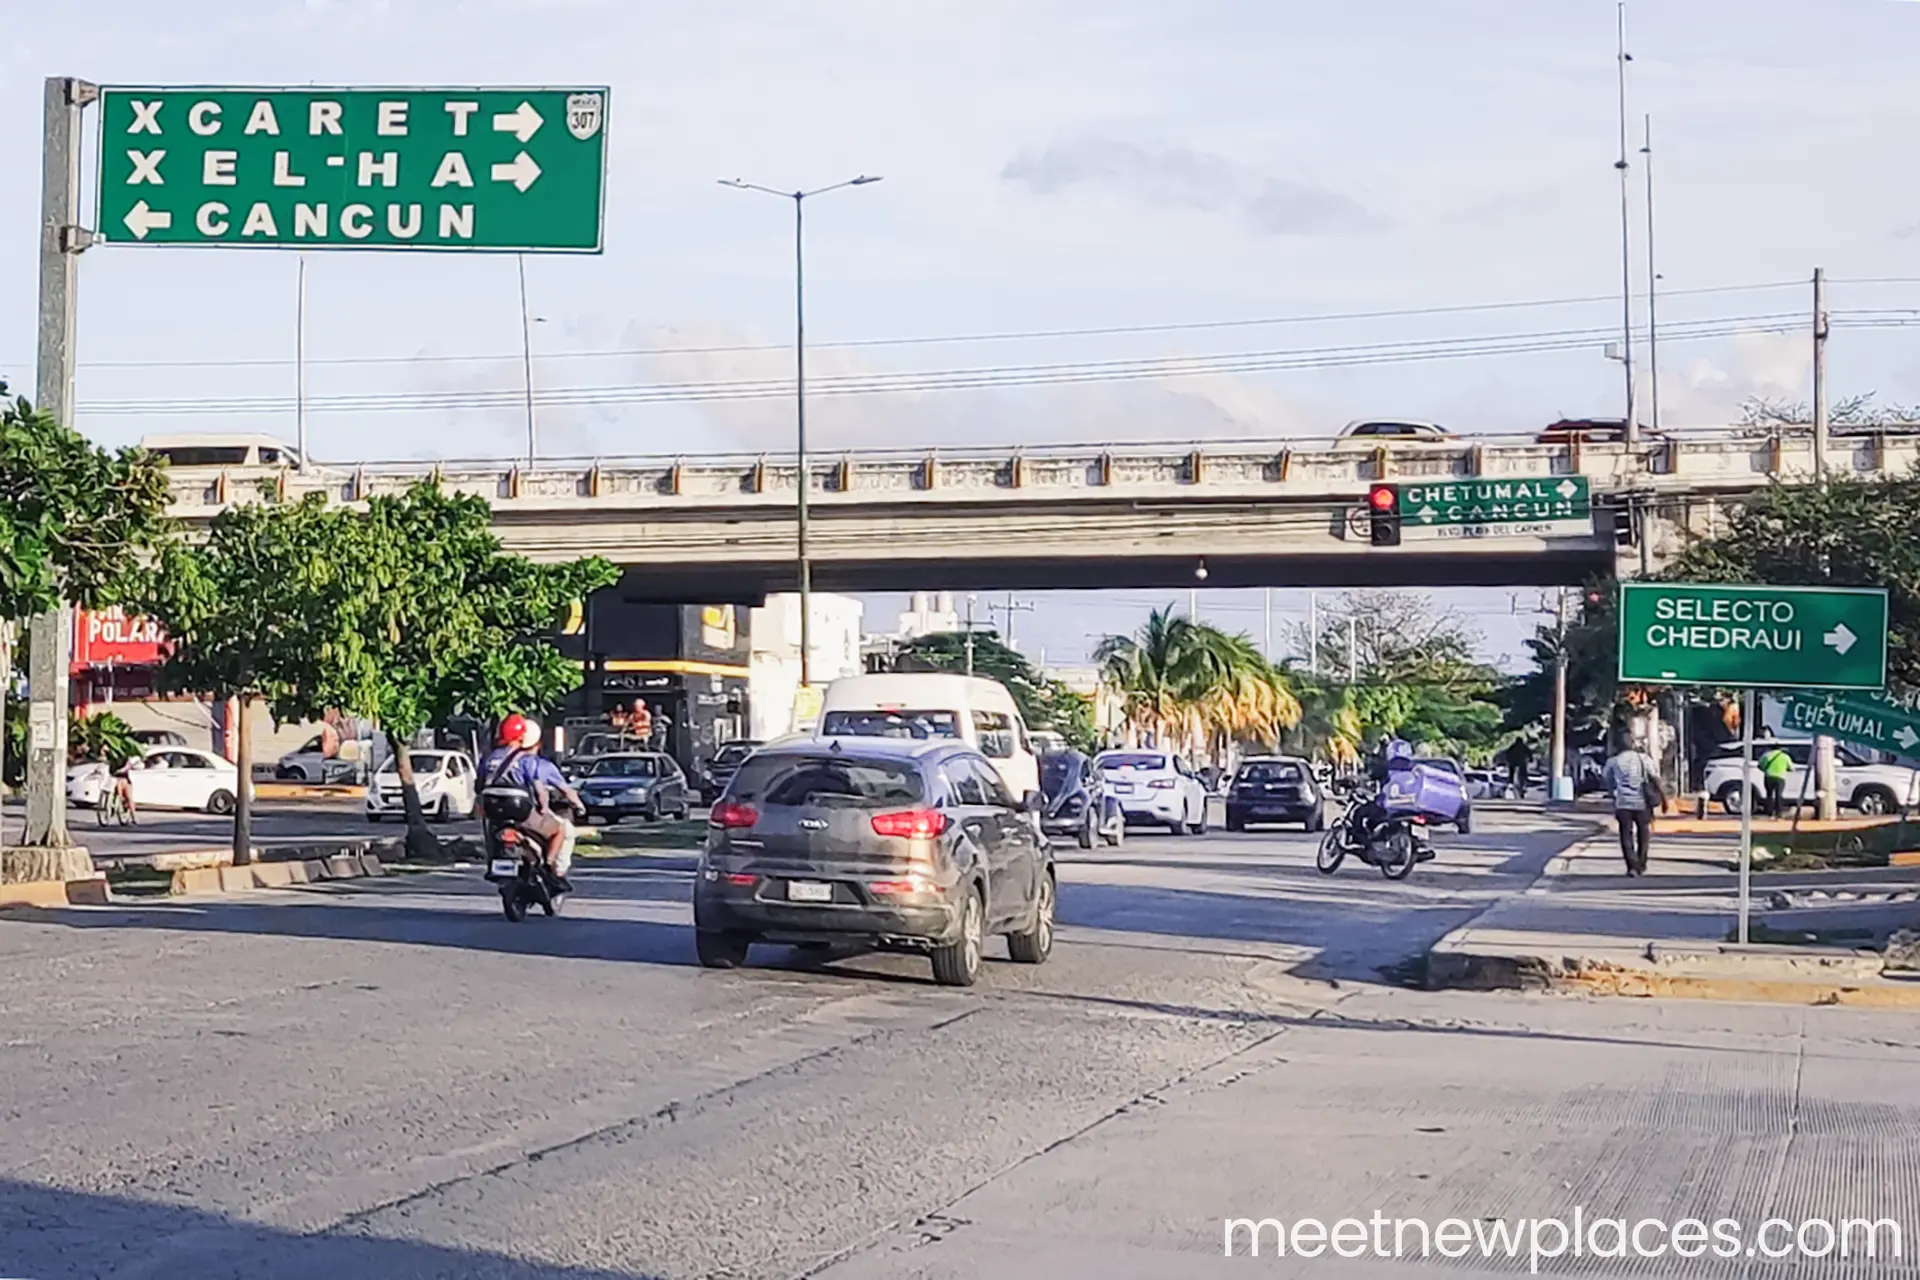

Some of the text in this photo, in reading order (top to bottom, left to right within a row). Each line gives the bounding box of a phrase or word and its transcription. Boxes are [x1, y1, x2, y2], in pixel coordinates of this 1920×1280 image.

[126, 100, 479, 136] XCARET
[572, 111, 595, 129] 307
[196, 201, 475, 238] CANCUN
[1407, 482, 1549, 503] CHETUMAL
[1447, 502, 1573, 520] CANCUN
[1655, 598, 1794, 623] SELECTO
[89, 619, 158, 643] POLAR
[1646, 624, 1801, 650] CHEDRAUI
[1794, 702, 1885, 741] CHETUMAL
